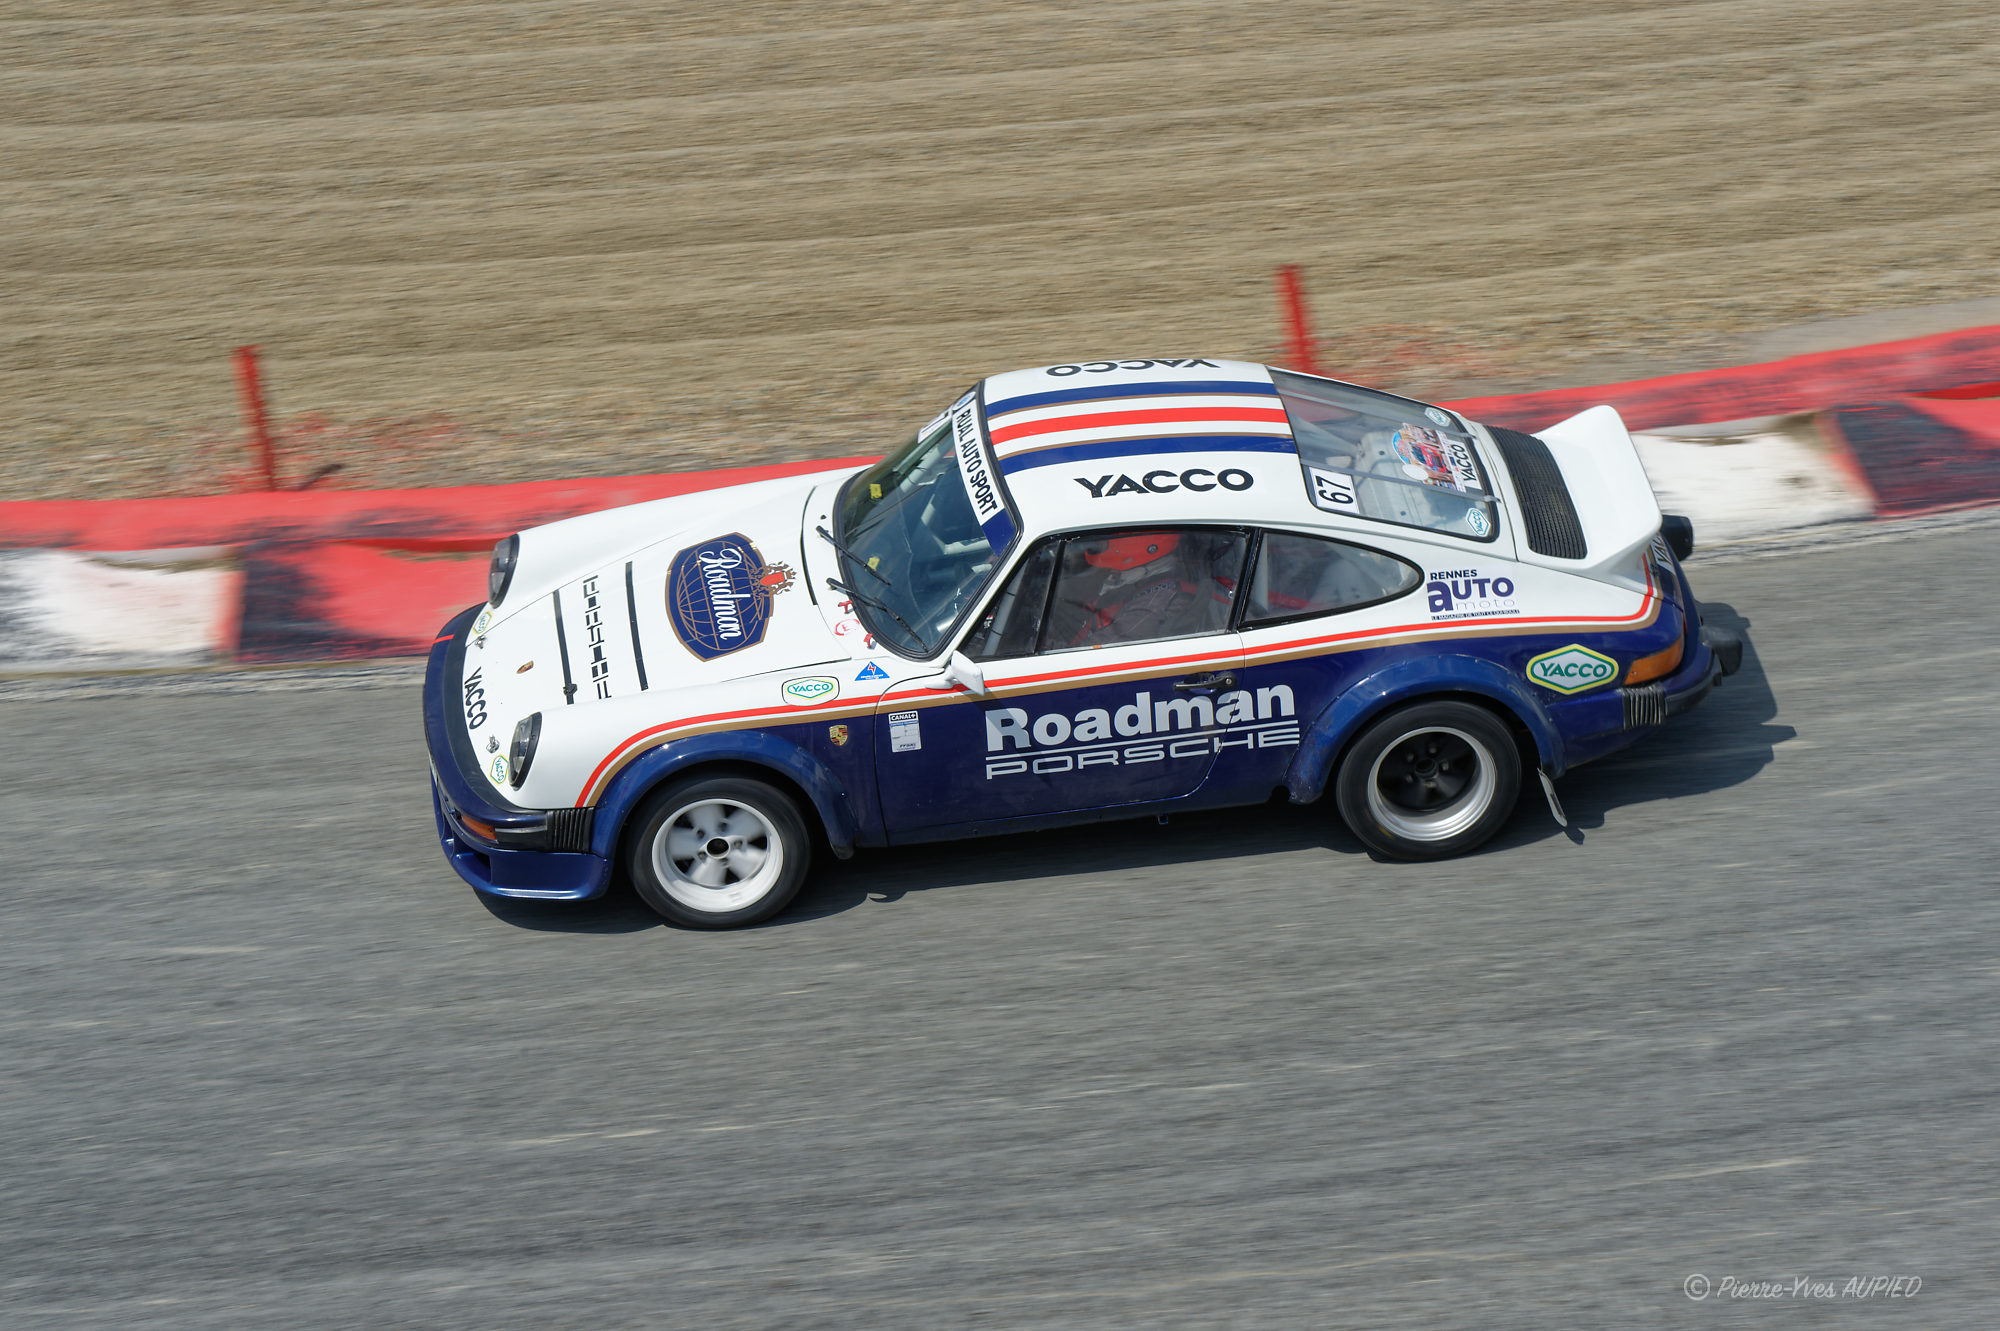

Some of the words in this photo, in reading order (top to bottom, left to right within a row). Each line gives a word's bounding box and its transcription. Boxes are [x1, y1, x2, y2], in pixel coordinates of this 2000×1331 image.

[1046, 358, 1221, 377] YACCO
[955, 408, 974, 442] RUAL
[961, 438, 982, 474] AUTO
[1450, 444, 1477, 481] YACCO
[970, 469, 997, 515] SPORT
[1073, 468, 1254, 498] YACCO
[1315, 475, 1354, 504] 67
[1430, 569, 1477, 581] RENNES
[698, 548, 751, 640] Roadman
[1456, 599, 1515, 610] moto
[1540, 662, 1608, 678] YACCO
[464, 666, 488, 729] YACCO
[792, 683, 830, 693] YACCO
[891, 712, 917, 722] CANAL+
[985, 683, 1295, 752] Roadman
[986, 727, 1300, 780] PORSCHE
